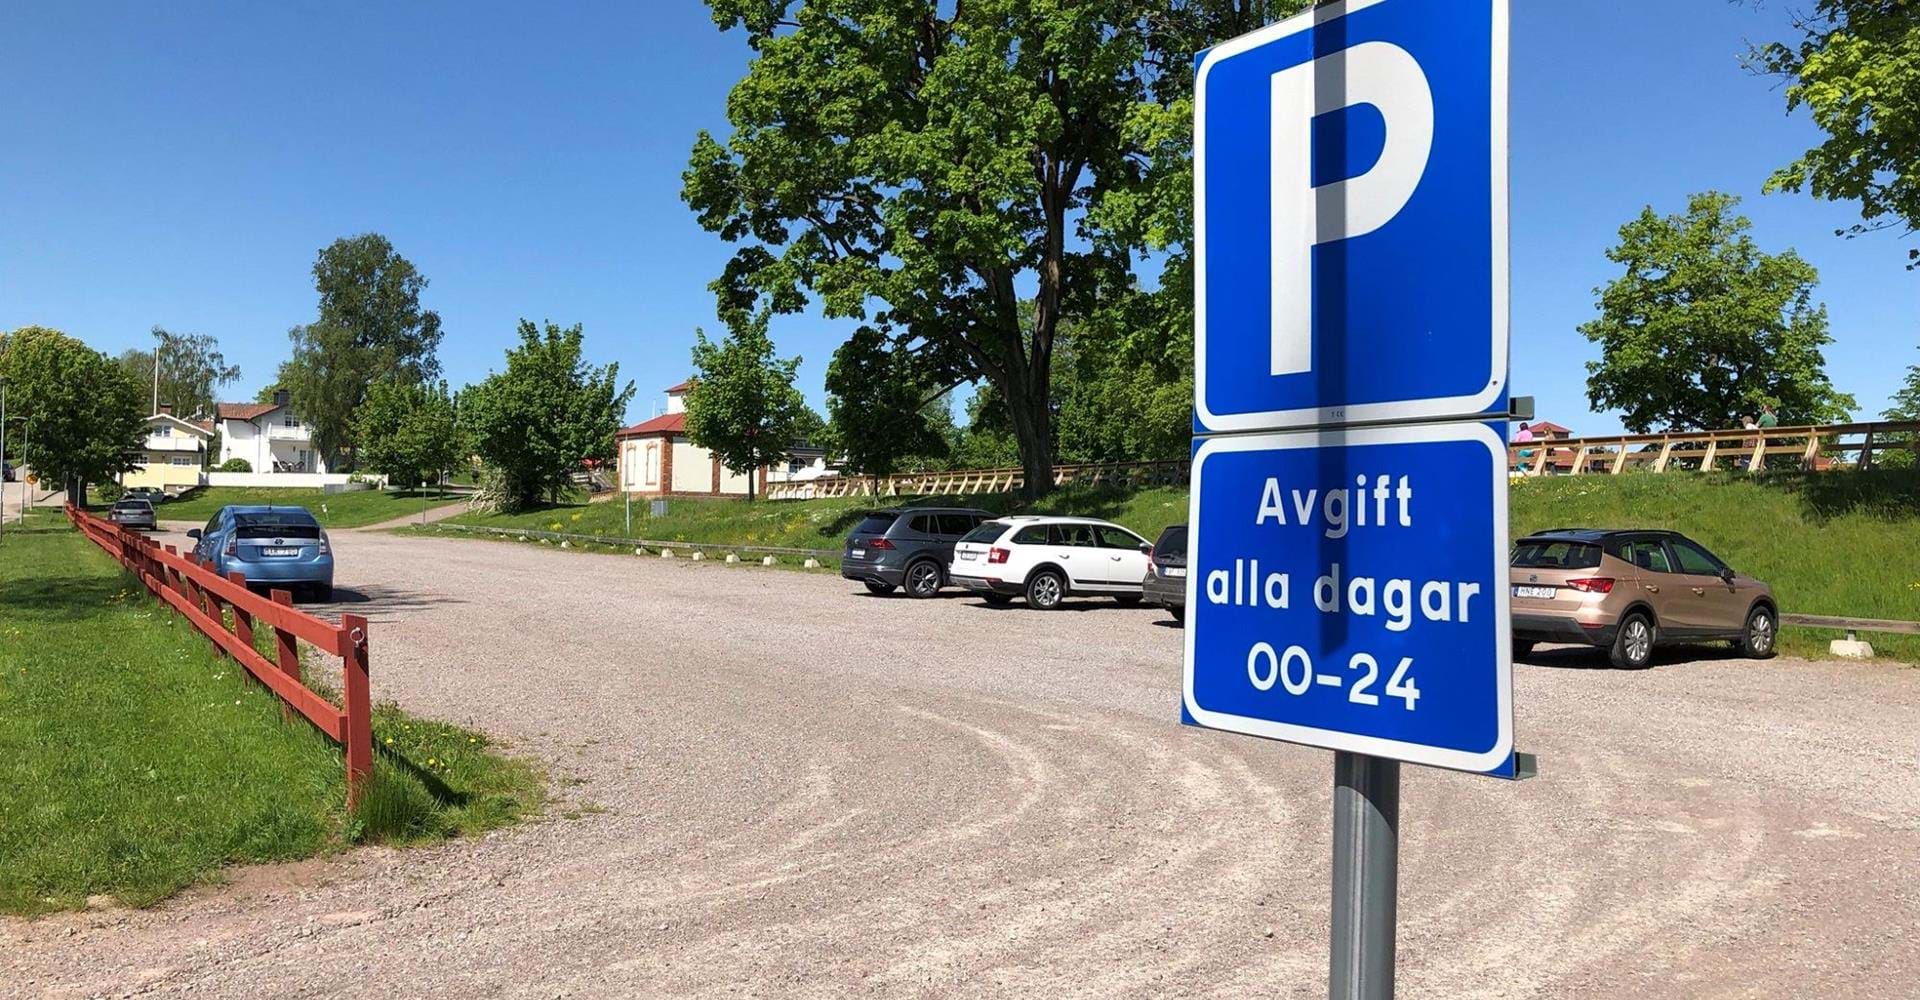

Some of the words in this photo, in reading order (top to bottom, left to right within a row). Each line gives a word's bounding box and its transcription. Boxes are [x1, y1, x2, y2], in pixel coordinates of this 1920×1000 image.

[1271, 41, 1433, 375] P
[1256, 474, 1412, 539] Avgift
[1206, 559, 1290, 609] alla
[1314, 563, 1480, 632] dagar
[1247, 641, 1421, 711] 00-24
